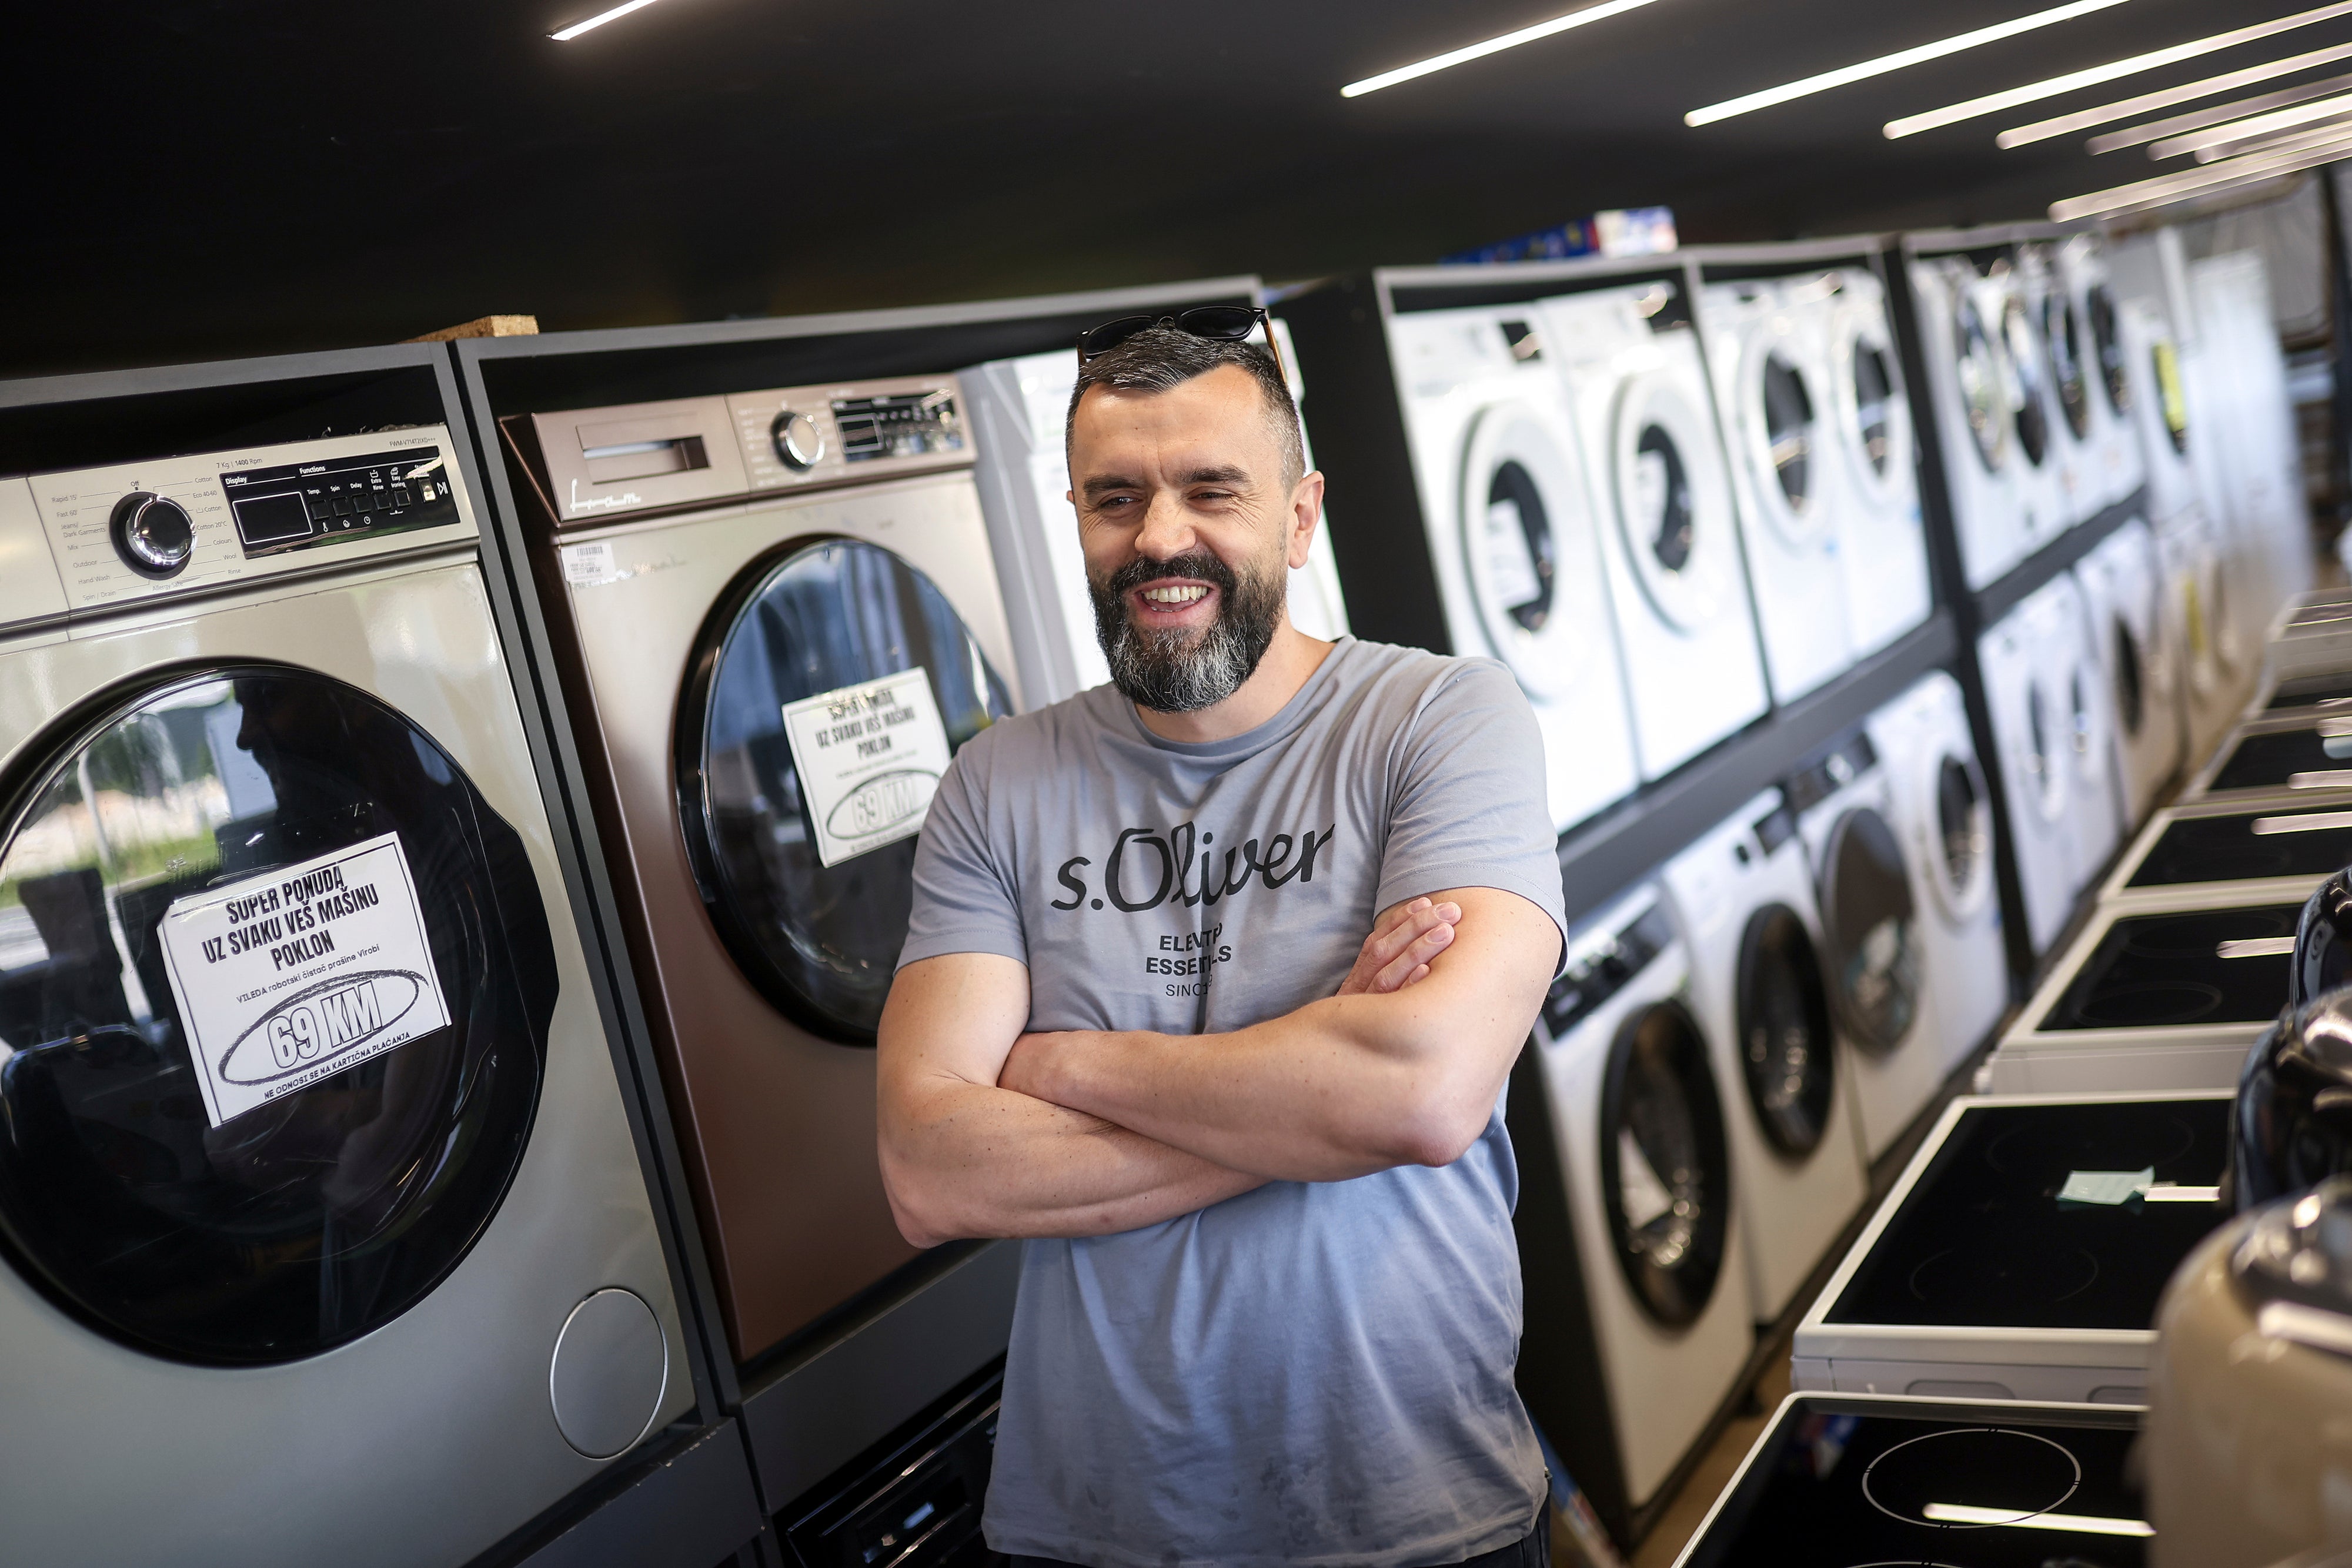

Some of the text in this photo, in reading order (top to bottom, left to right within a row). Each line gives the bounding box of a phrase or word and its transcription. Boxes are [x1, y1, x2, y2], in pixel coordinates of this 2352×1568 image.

[249, 457, 263, 466] Rpm
[299, 465, 326, 474] Functions
[225, 476, 247, 484] Display
[51, 495, 68, 503] Rapid
[78, 527, 106, 536] Garments
[72, 559, 98, 569] Outdoor
[78, 577, 93, 585] Hand
[152, 583, 171, 592] Allergy
[82, 594, 95, 602] Spin
[1050, 821, 1335, 913] s.Oliver
[225, 866, 345, 925] SUPER PONUDA
[201, 882, 379, 964] UZ SVAKU VEŠ MAŠINU
[269, 929, 335, 971] POKLON
[236, 944, 380, 1004] VILEDA robotski čistač prašine Virobi
[267, 981, 383, 1069] 69 KM
[264, 1031, 410, 1100] NE ODNOSI SE NA KARTIČNA PLAĆANJA
